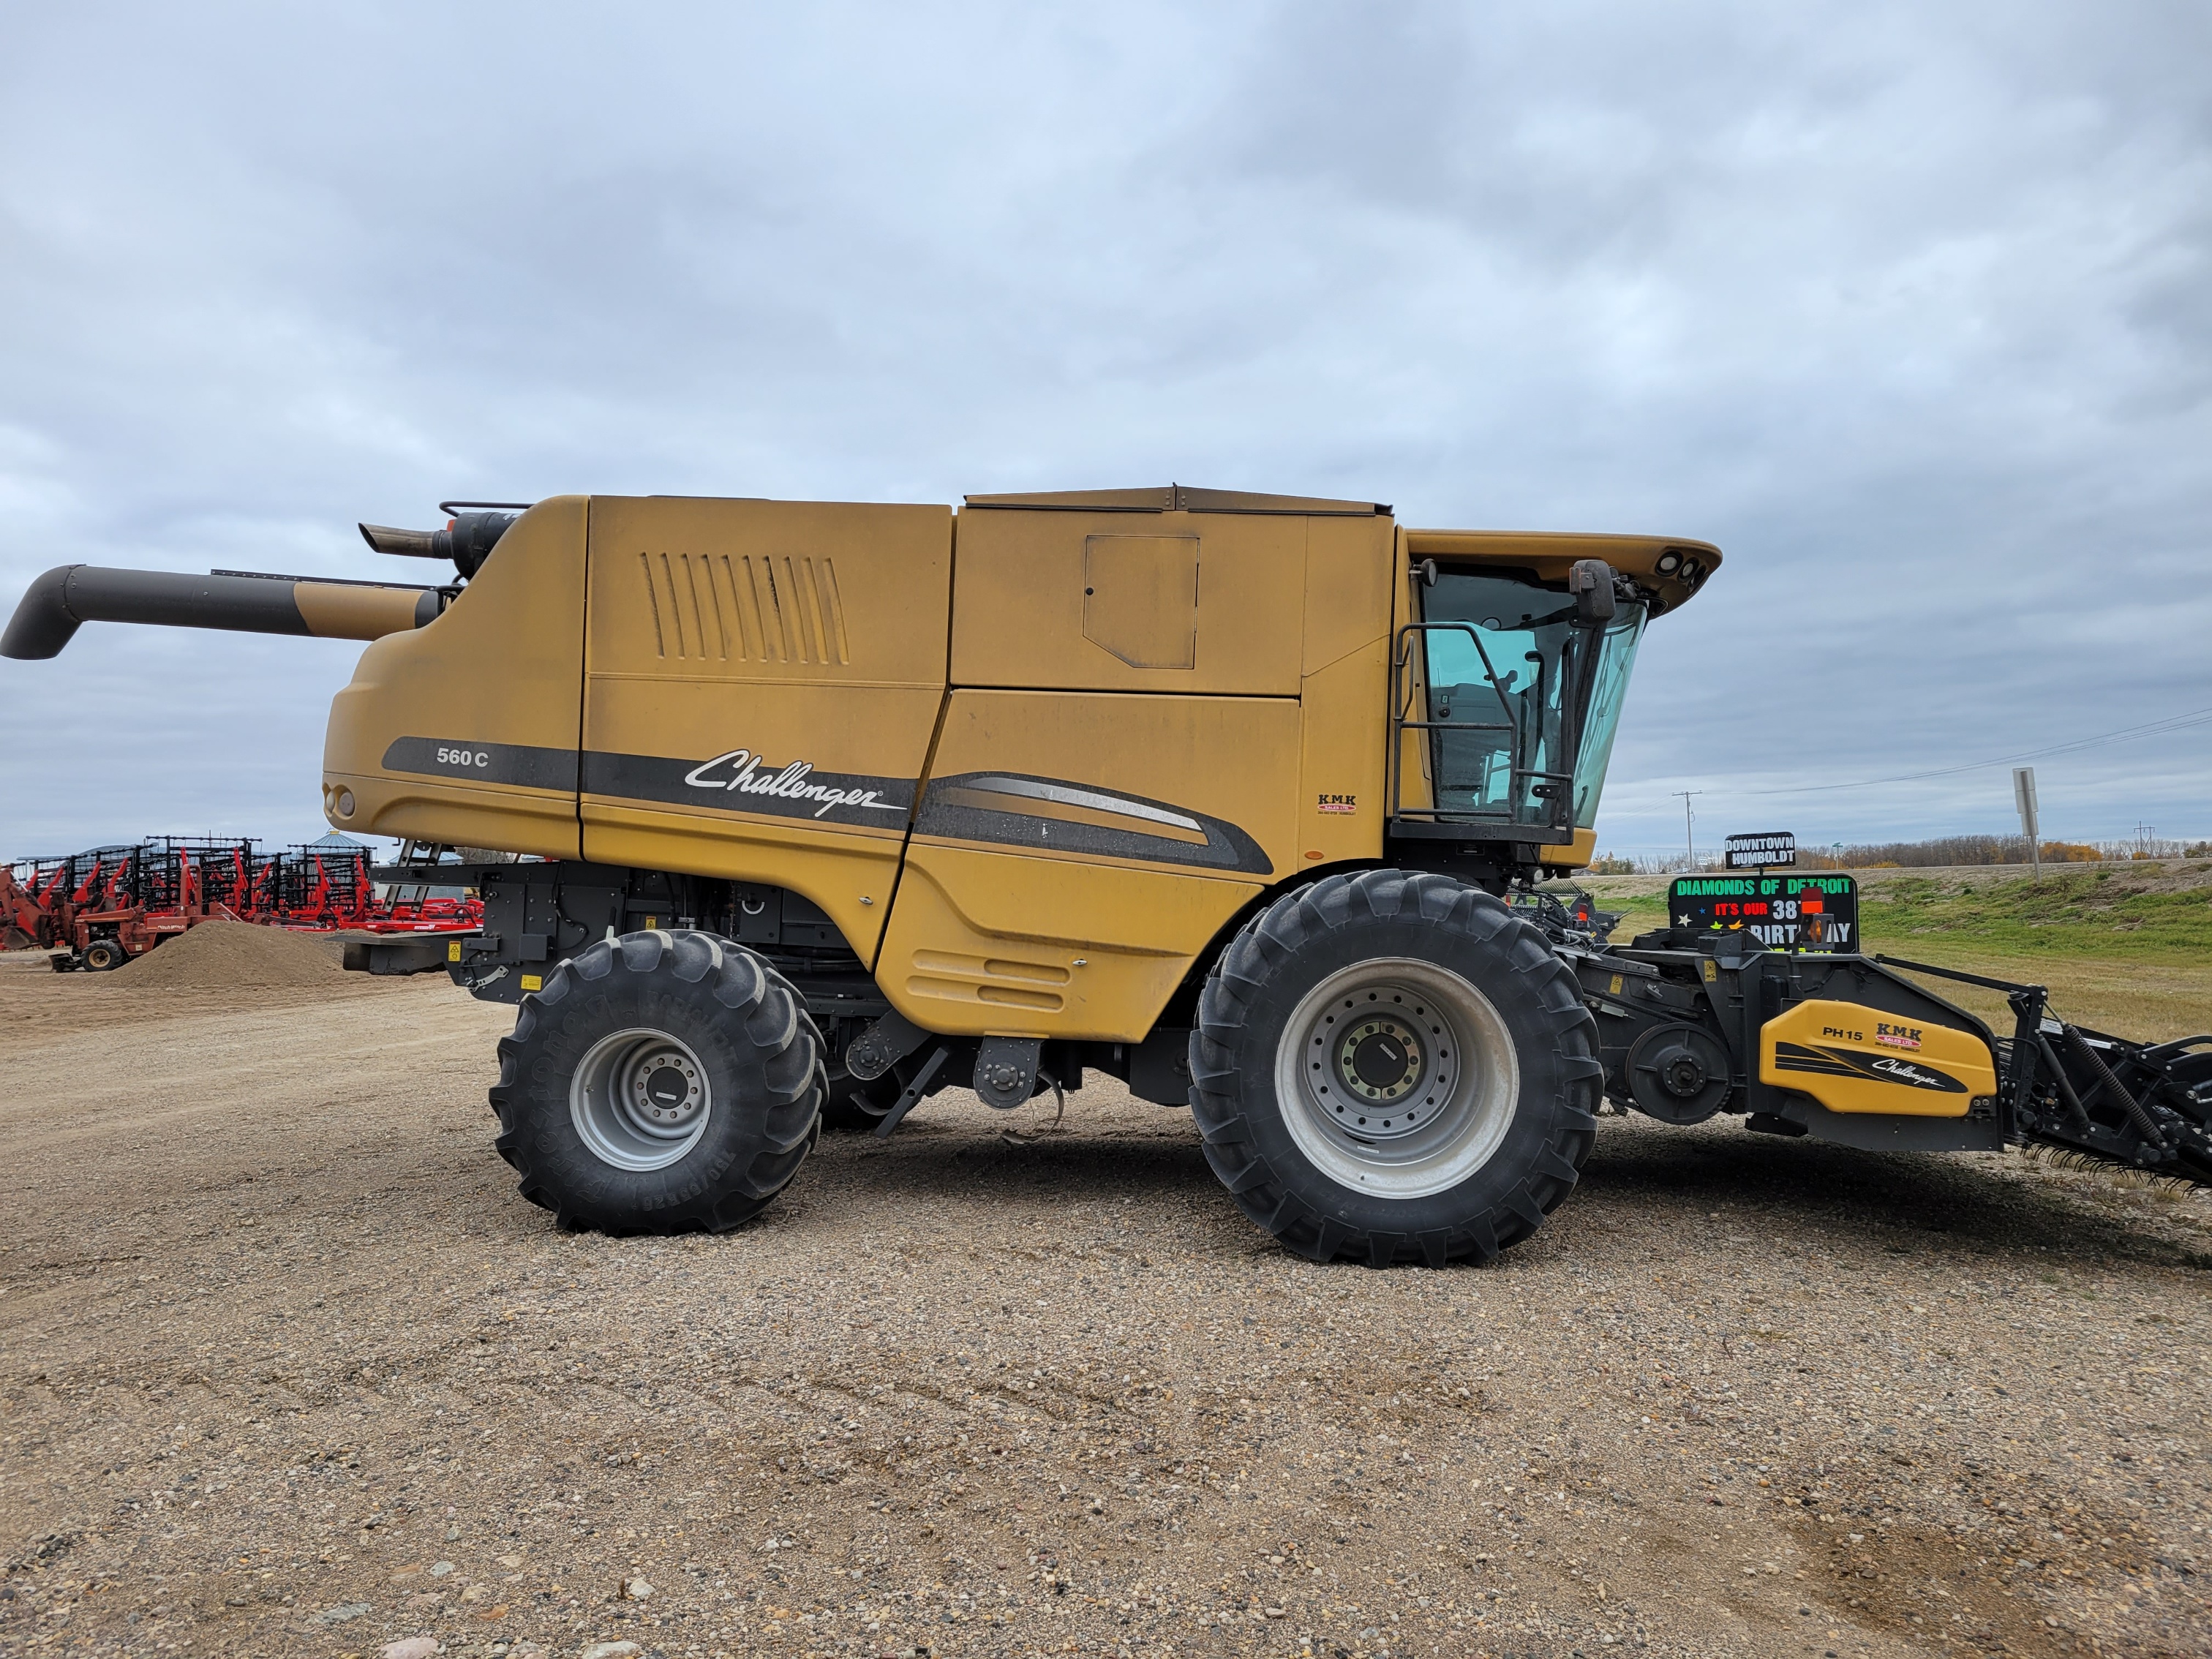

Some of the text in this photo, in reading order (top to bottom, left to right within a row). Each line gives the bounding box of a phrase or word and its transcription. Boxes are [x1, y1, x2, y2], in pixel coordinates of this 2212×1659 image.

[437, 748, 489, 767] 560 C
[685, 750, 908, 817] Challenger
[1725, 836, 1794, 852] DOWNTOWN
[1732, 850, 1795, 865] HUMBOLDT
[1677, 880, 1755, 896] DIAMONDS
[1760, 879, 1780, 895] OF
[1715, 903, 1739, 916] IT'S
[1743, 902, 1768, 916] OUR
[1750, 923, 1851, 944] BIRTAY
[1823, 1027, 1863, 1041] PH 15
[1872, 1058, 1946, 1088] Challenger
